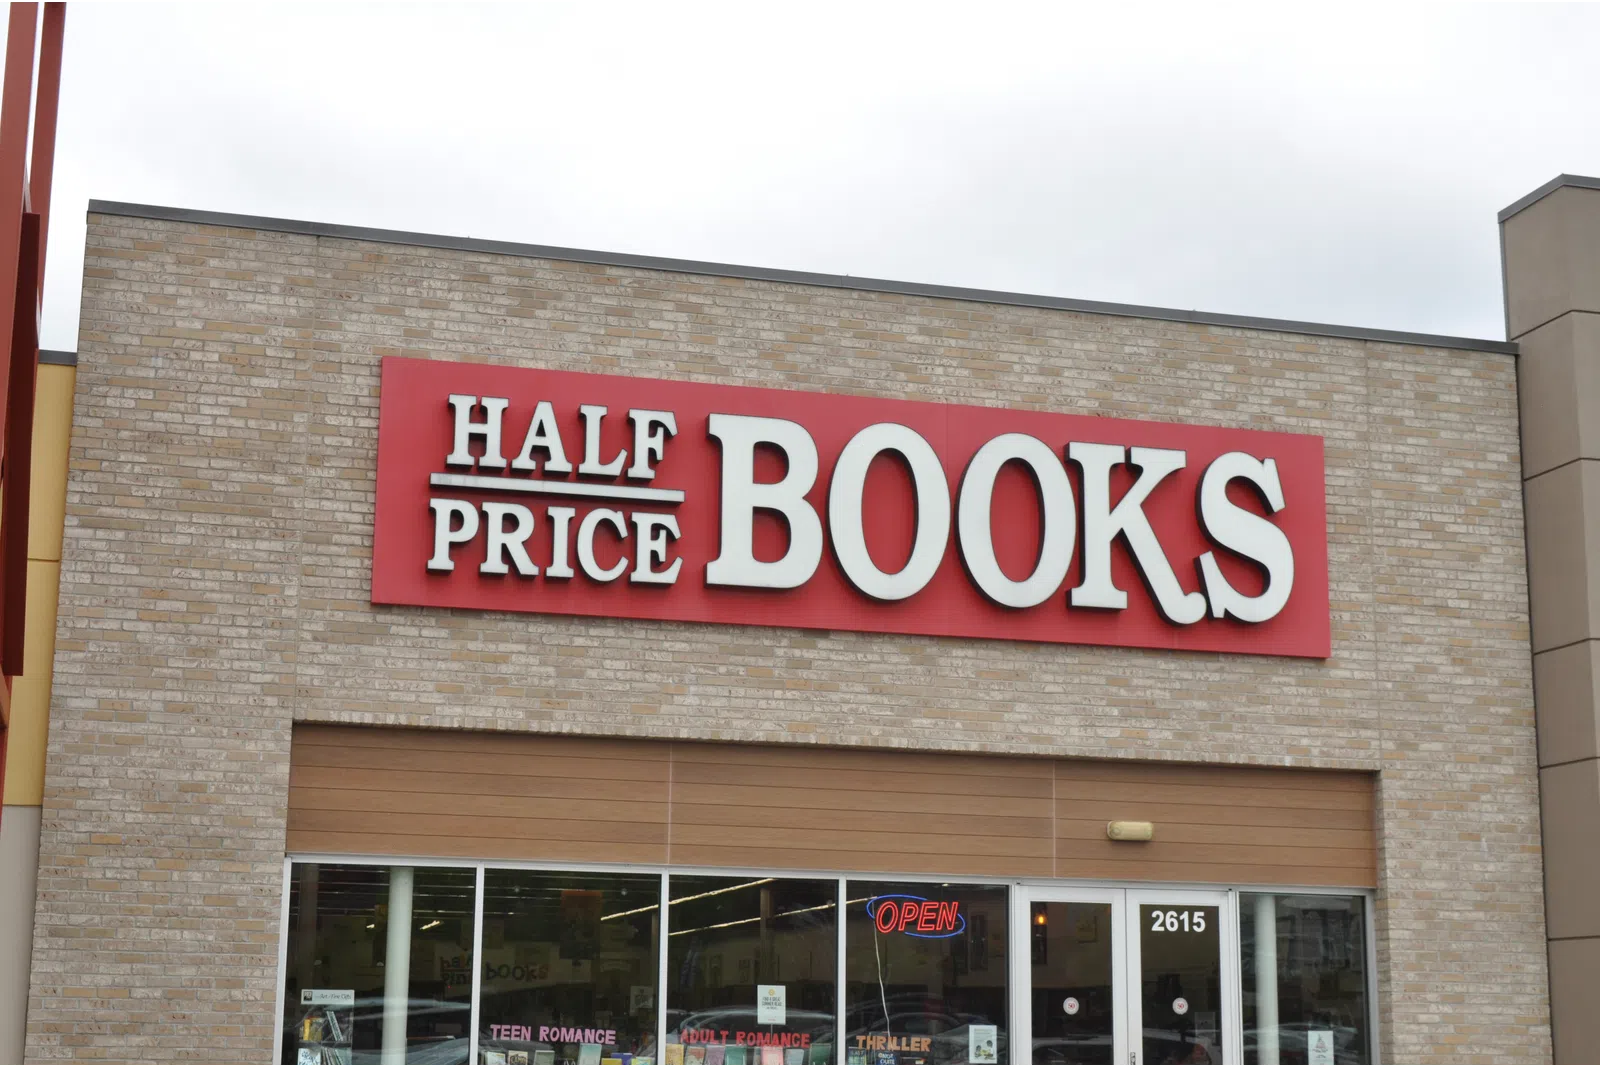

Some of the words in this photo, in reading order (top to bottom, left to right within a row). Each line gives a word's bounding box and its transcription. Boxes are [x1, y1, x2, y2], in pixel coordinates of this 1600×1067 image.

[446, 393, 678, 480] HALF
[705, 413, 1294, 625] BOOKS
[426, 497, 683, 584] PRICE
[875, 901, 959, 933] OPEN
[1151, 910, 1206, 933] 2615
[490, 1024, 531, 1041] TEEN
[539, 1026, 616, 1045] ROMANCE
[680, 1028, 729, 1044] ADULT
[736, 1031, 811, 1048] ROMANCE
[856, 1035, 932, 1052] THRILLER
